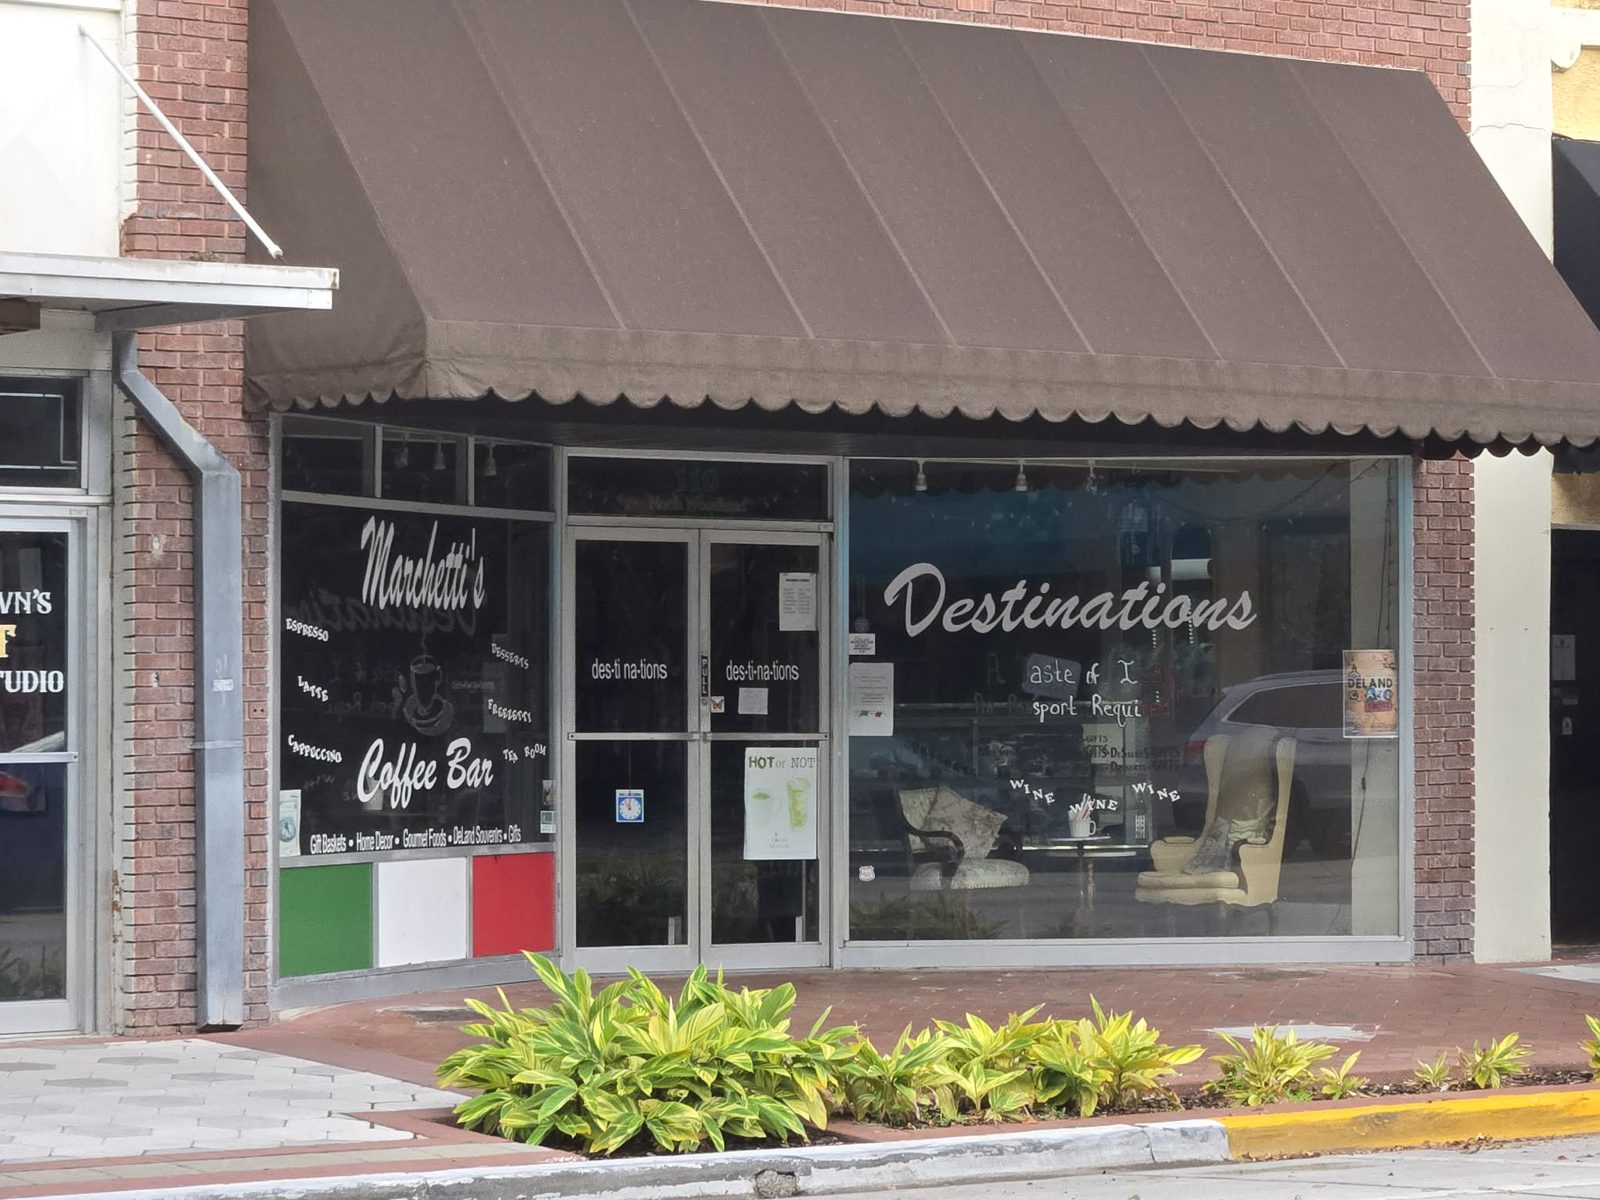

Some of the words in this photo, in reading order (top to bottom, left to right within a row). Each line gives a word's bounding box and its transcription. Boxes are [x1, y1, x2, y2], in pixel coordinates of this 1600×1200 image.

[360, 515, 485, 609] Marchetti's
[884, 562, 1258, 638] Destinations
[285, 617, 329, 642] ESPRESSO
[491, 643, 529, 670] DESSERTS
[1086, 662, 1100, 685] of
[1348, 678, 1393, 689] DELAND
[297, 676, 328, 702] LATTE
[288, 734, 343, 763] CAPPUCCINO
[503, 749, 519, 764] TEA
[524, 743, 547, 759] ROOM
[356, 737, 437, 810] Coffee
[446, 737, 494, 790] Bar
[748, 757, 775, 769] HOT
[775, 760, 786, 769] or
[791, 757, 815, 769] NOT
[1009, 779, 1056, 804] WINE
[1131, 782, 1181, 803] WINE
[1069, 798, 1118, 815] WINE
[310, 834, 322, 855] Gift
[322, 833, 347, 854] Baskets
[356, 832, 375, 852] Home
[375, 831, 394, 851] Decor
[403, 828, 428, 849] Gourmet
[429, 828, 447, 848] Foods
[453, 826, 475, 845] DeLand
[508, 824, 522, 843] Gifts
